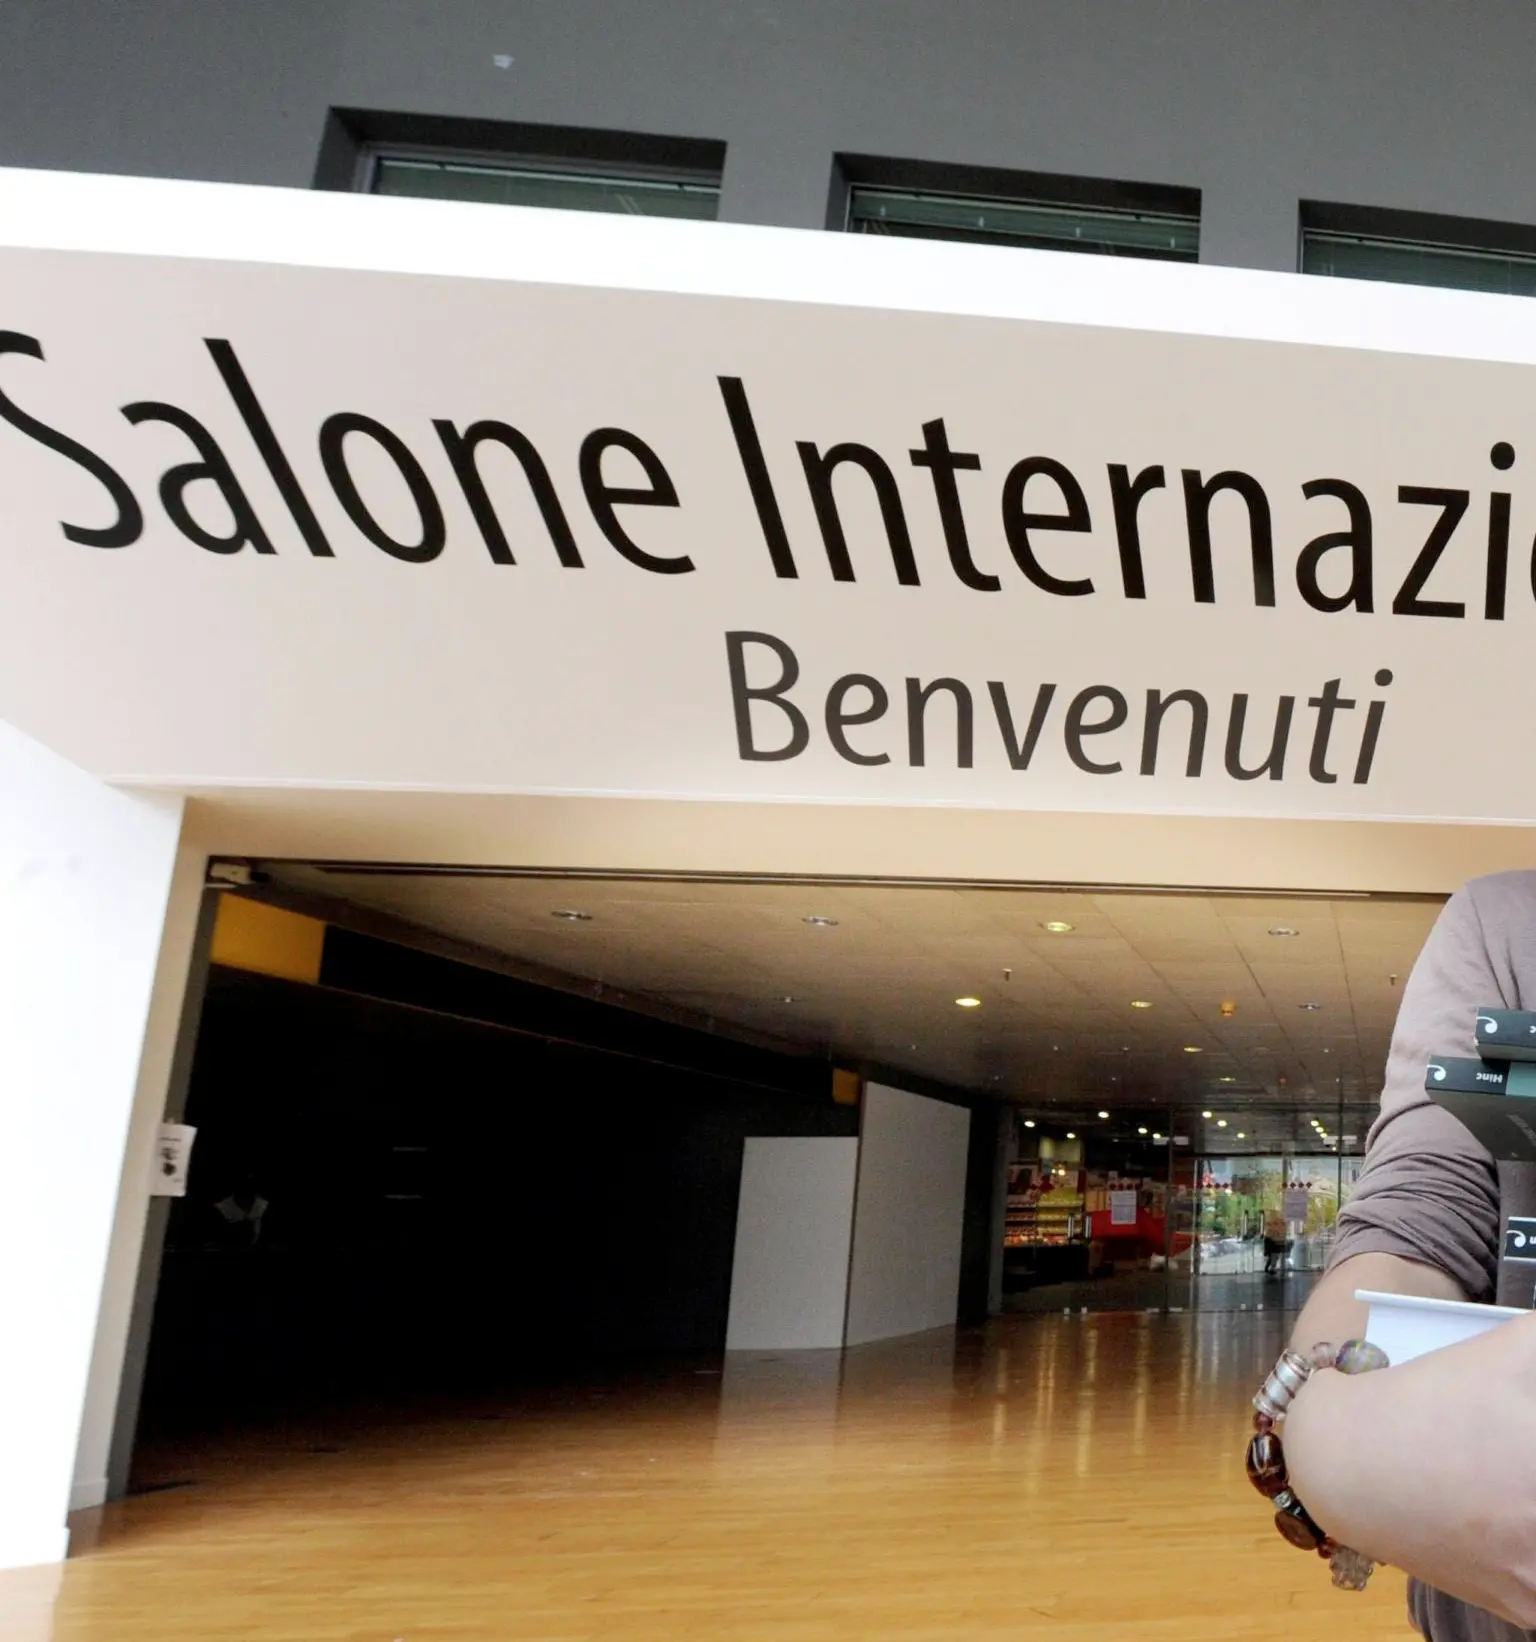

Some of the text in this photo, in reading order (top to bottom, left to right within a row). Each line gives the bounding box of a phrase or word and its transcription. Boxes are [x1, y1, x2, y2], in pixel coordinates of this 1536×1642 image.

[0, 329, 696, 575] Salone
[725, 630, 1393, 785] Benvenuti
[1476, 1071, 1503, 1083] Hinc
